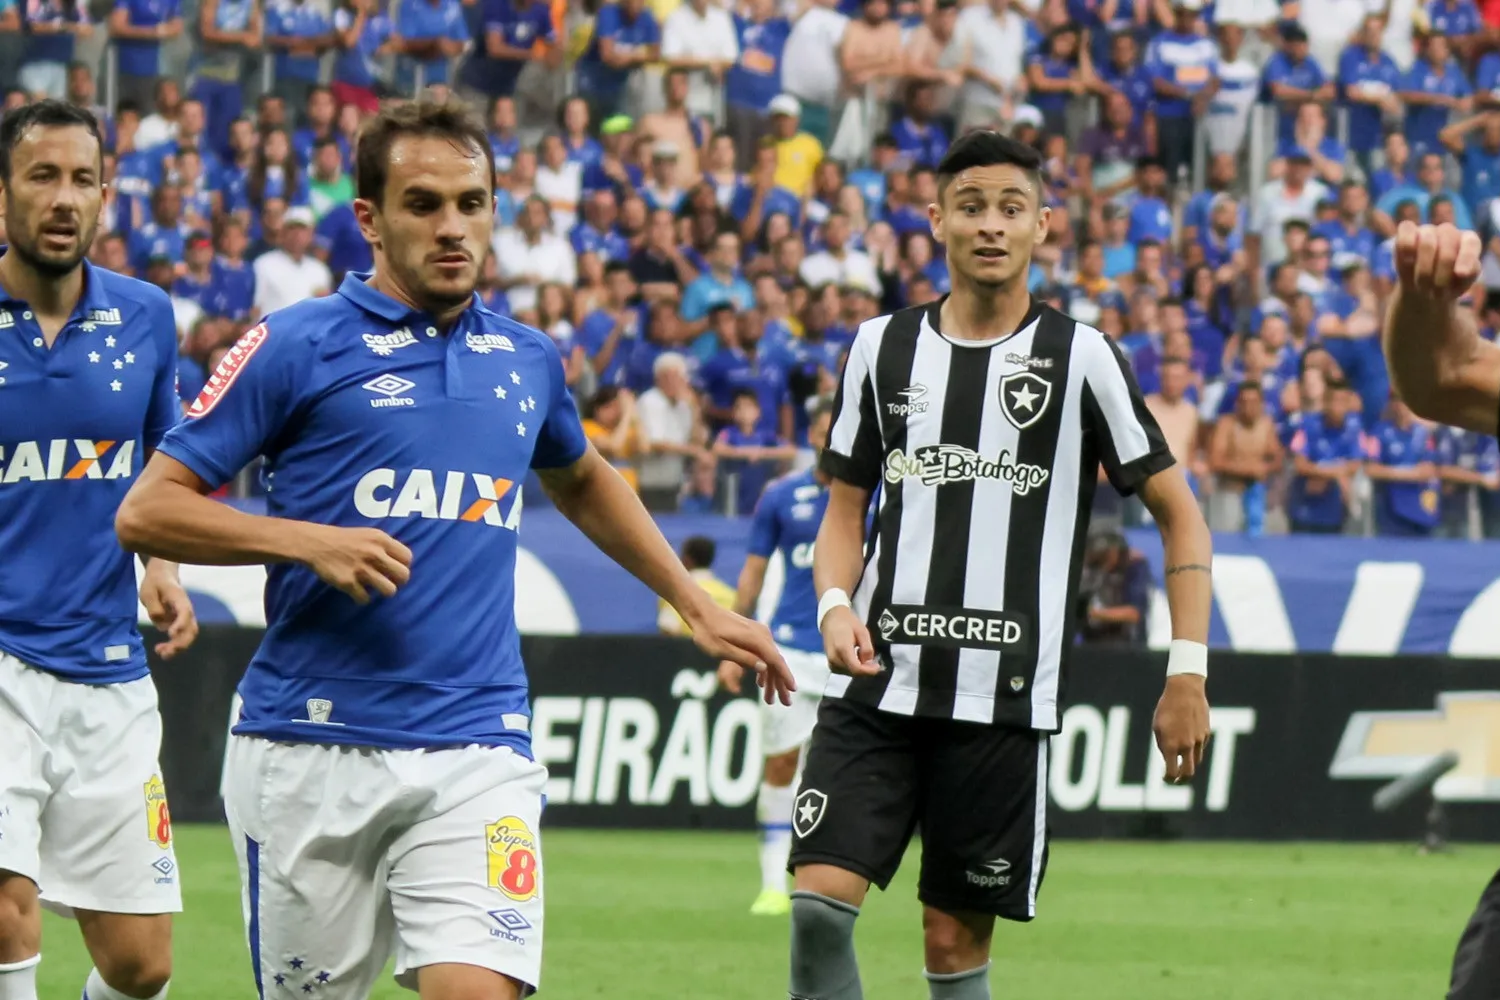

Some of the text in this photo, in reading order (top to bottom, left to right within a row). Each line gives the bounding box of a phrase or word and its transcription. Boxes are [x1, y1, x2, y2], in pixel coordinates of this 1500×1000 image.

[370, 394, 415, 408] umbro
[887, 401, 929, 417] Topper
[0, 438, 136, 484] AIXA
[886, 449, 1049, 496] Sou Botafogo
[353, 467, 524, 536] CAIXA
[903, 612, 1022, 645] CERCRED
[156, 801, 171, 845] 8
[489, 825, 535, 853] Super
[500, 848, 537, 896] 8
[966, 870, 1012, 887] Topper
[489, 927, 526, 947] umbro
